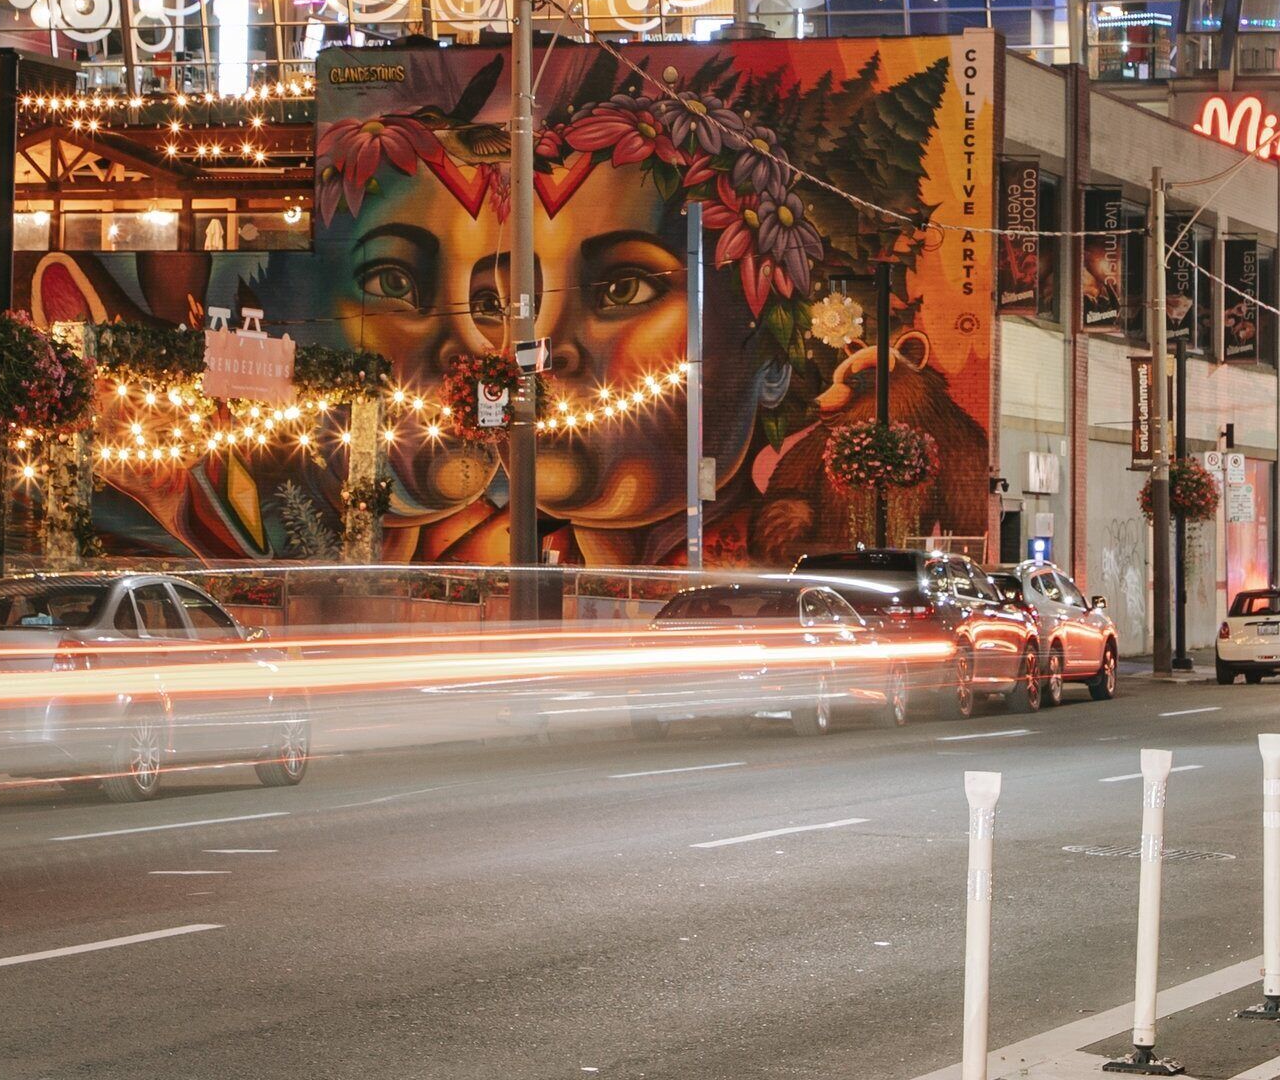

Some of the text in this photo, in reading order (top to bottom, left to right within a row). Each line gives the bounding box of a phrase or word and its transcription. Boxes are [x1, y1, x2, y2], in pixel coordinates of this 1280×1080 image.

[962, 49, 977, 216] COLLECTIVE
[1007, 184, 1021, 241] events
[1104, 200, 1122, 287] live music
[961, 230, 976, 297] ARTS
[1173, 258, 1190, 290] sips
[1239, 250, 1257, 286] tasty
[1137, 363, 1149, 453] entertainment
